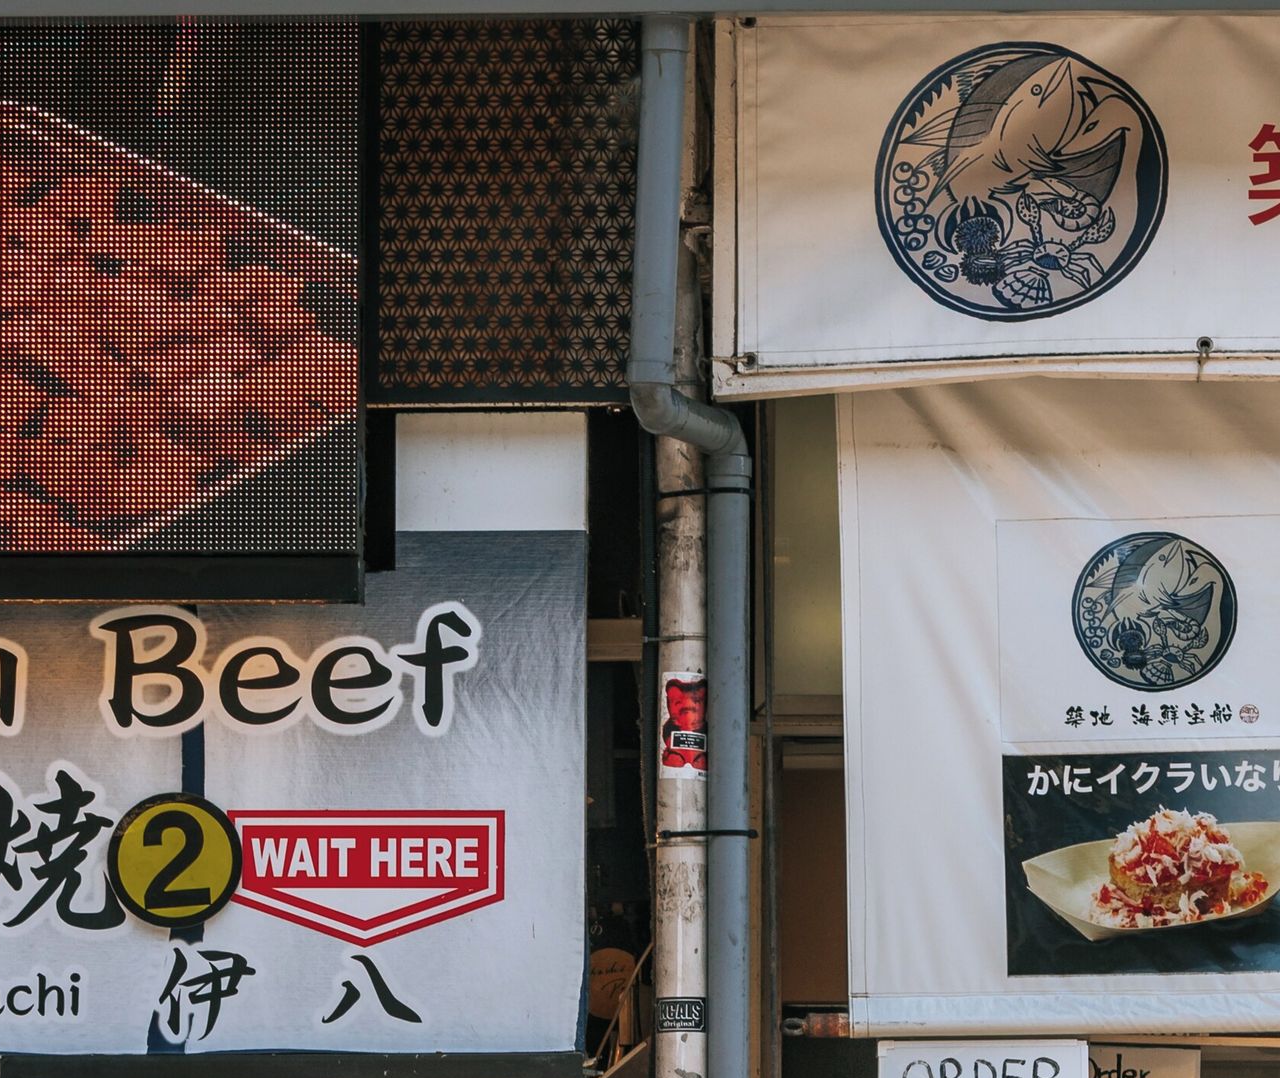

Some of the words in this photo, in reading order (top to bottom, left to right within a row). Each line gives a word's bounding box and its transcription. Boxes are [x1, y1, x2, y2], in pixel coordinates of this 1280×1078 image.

[97, 611, 472, 729] Beef
[1131, 702, 1233, 727] 海鮮宝船
[141, 810, 214, 911] 2
[250, 837, 357, 878] WAIT
[370, 837, 479, 878] HERE
